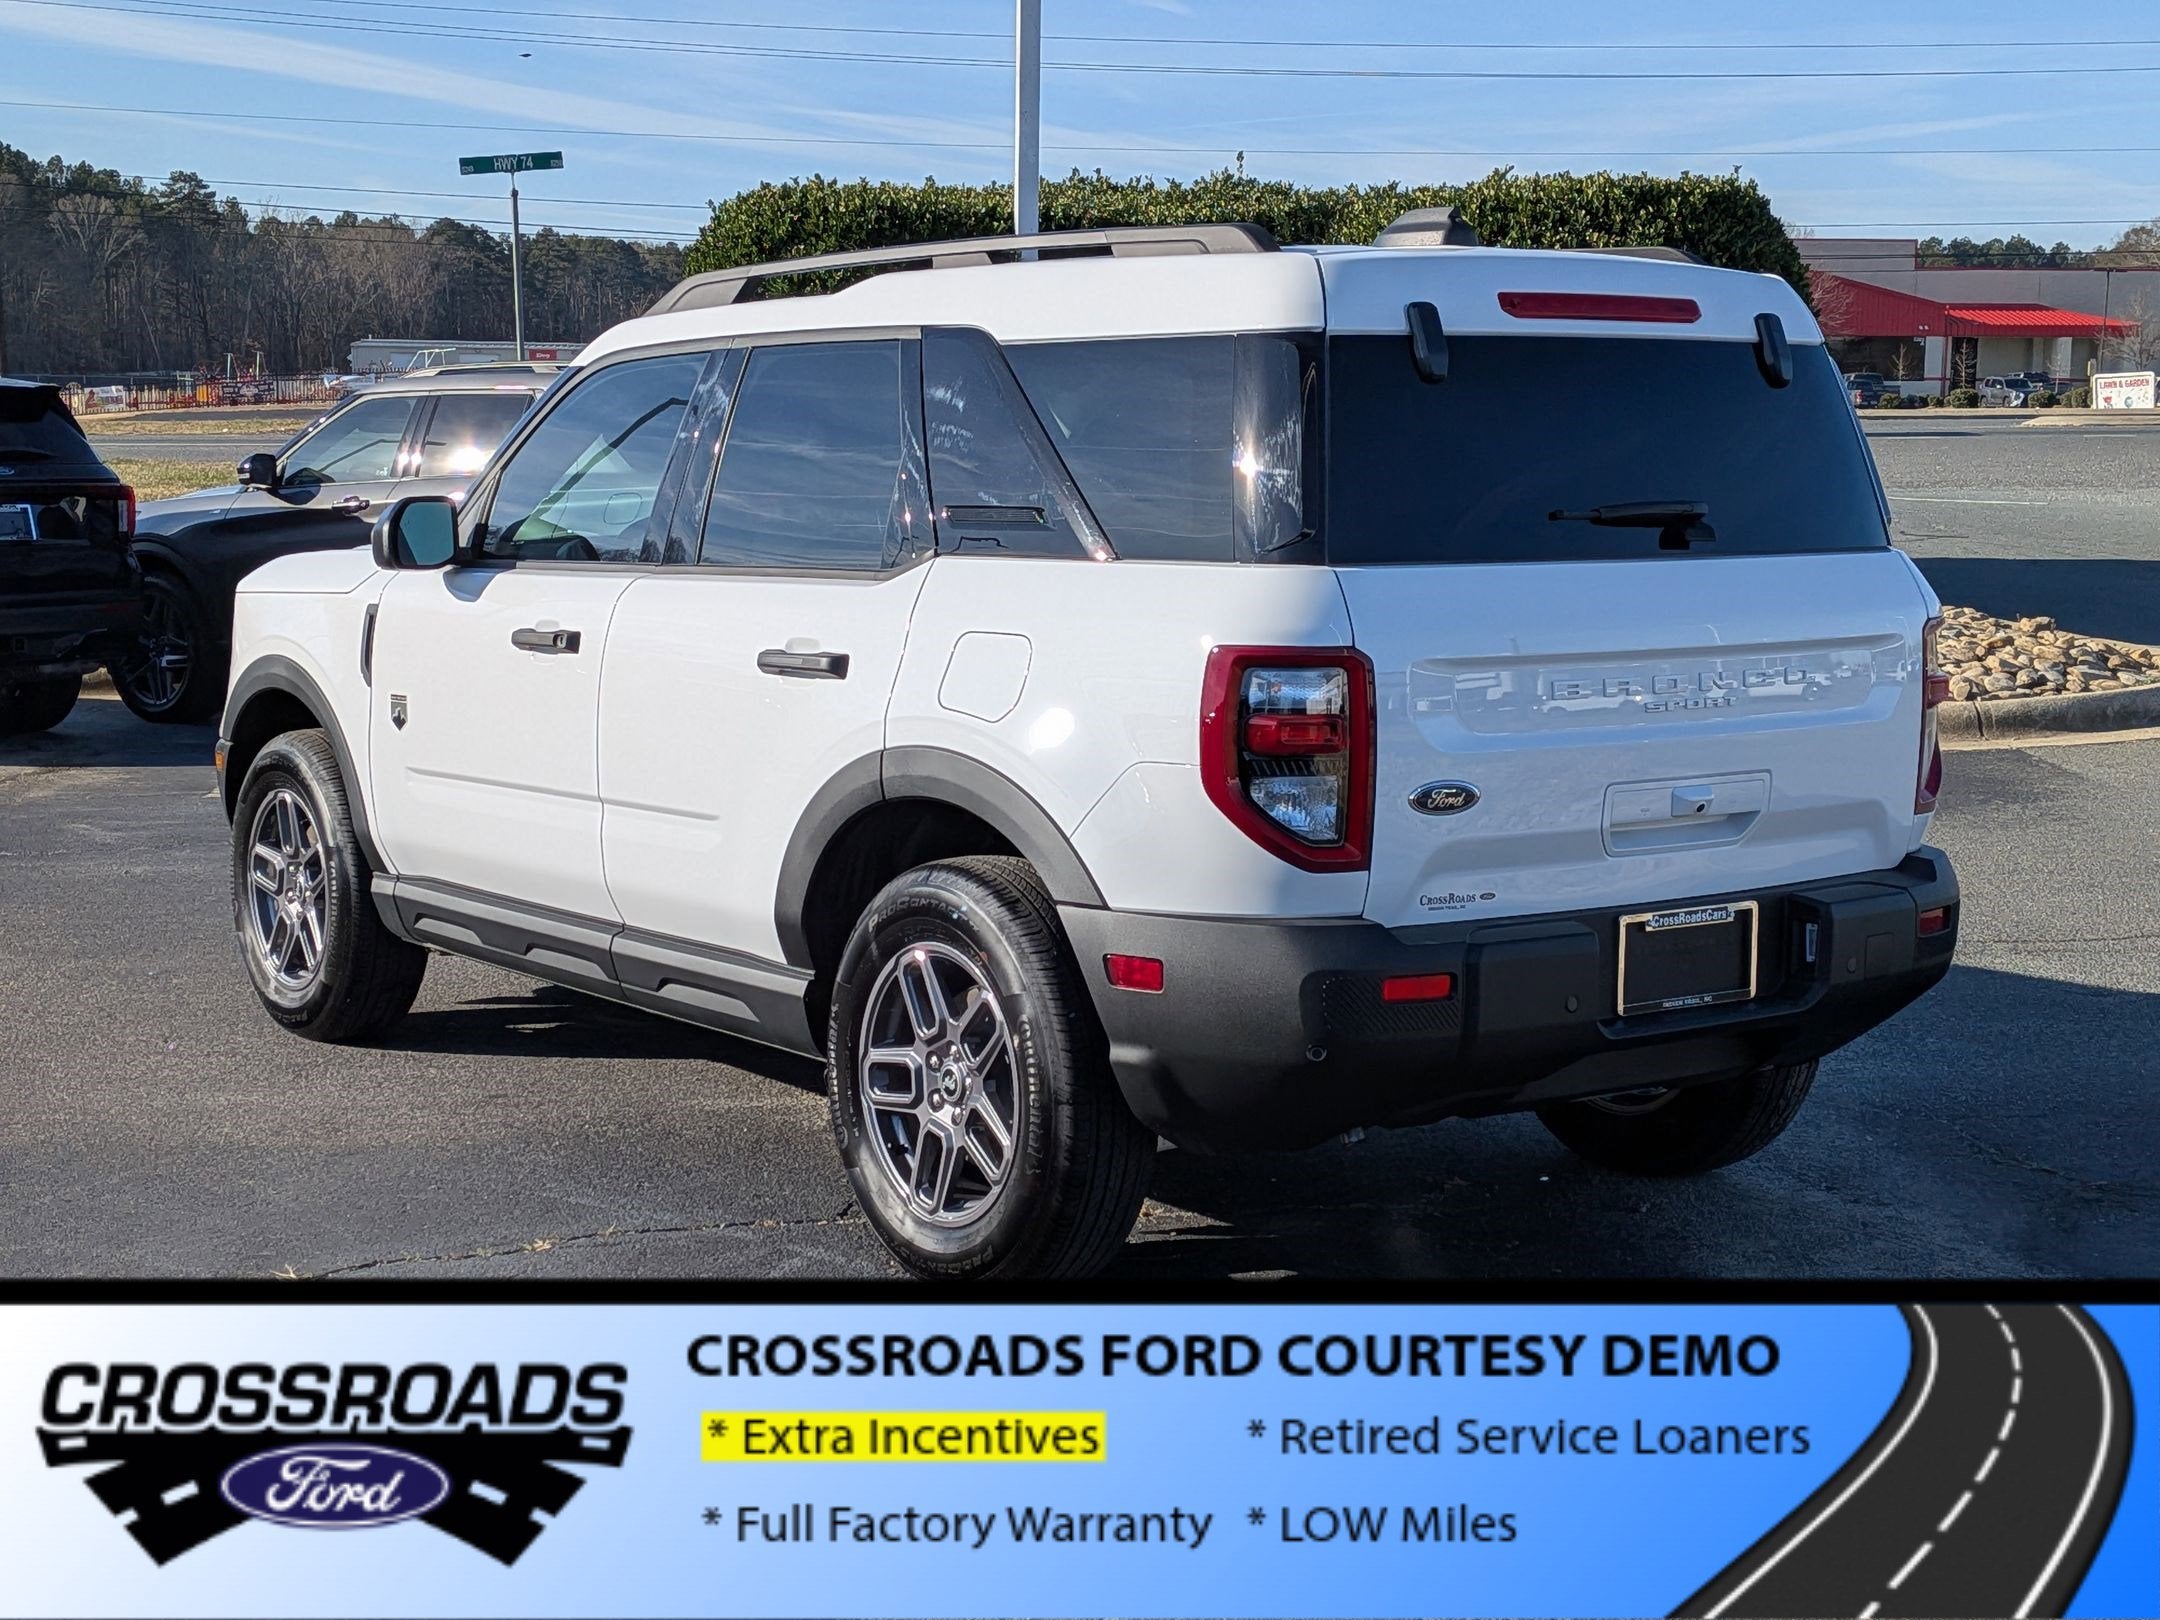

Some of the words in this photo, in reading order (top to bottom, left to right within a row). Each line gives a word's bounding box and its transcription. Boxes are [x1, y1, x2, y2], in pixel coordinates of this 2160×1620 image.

[493, 157, 518, 171] HWY
[520, 155, 534, 169] 74
[1551, 666, 1808, 701] BRONCO
[1644, 696, 1735, 713] SPORT
[1427, 789, 1466, 809] Ford
